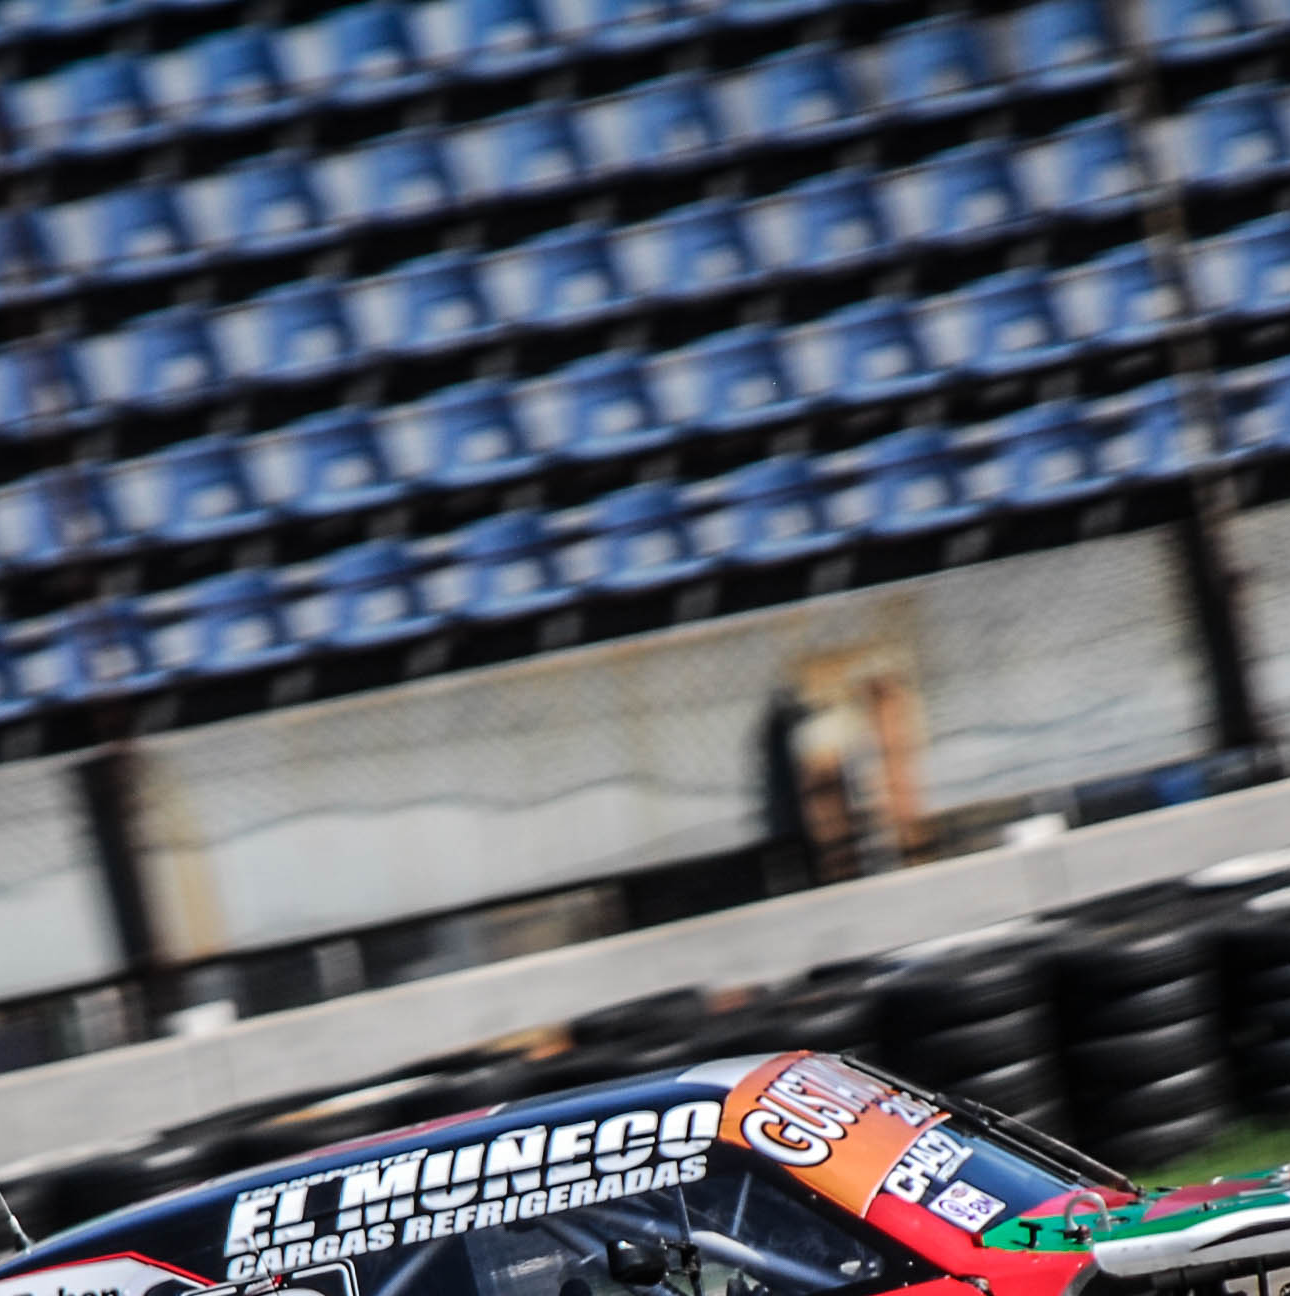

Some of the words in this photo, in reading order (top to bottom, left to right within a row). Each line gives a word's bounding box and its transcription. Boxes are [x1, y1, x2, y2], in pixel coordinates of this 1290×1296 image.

[223, 1186, 316, 1257] EL
[226, 1221, 396, 1281] CARGAS
[402, 1155, 708, 1245] REFRIGERADAS
